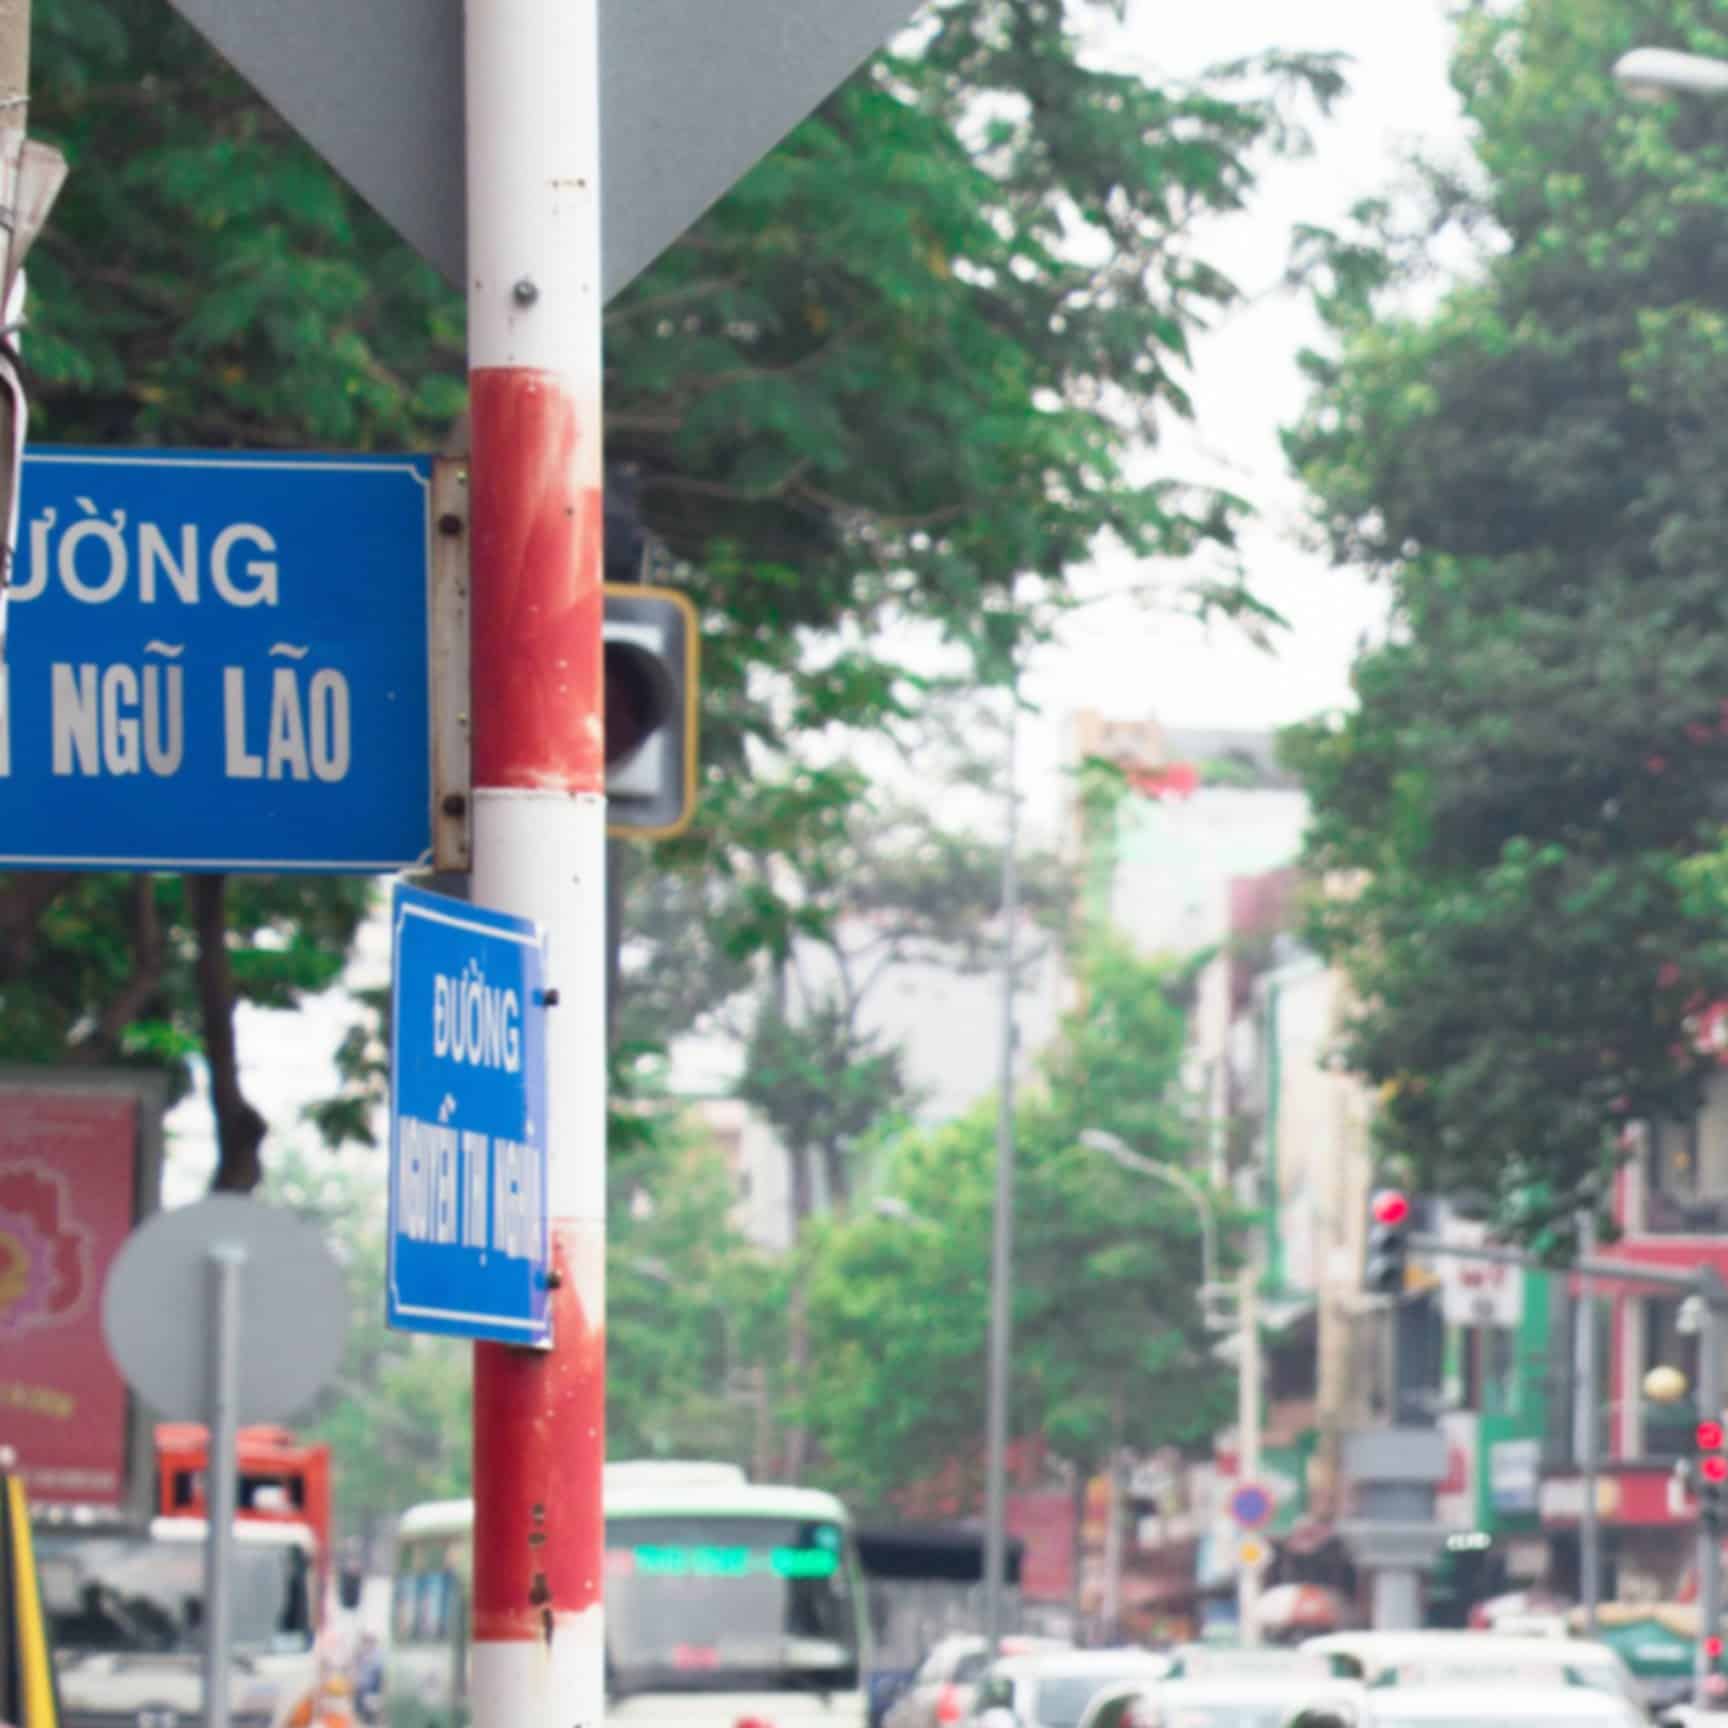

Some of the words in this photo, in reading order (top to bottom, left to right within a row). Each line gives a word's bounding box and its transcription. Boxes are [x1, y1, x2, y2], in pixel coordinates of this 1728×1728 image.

[51, 640, 185, 778] NGŨ
[222, 642, 351, 782] LÃO
[431, 957, 521, 1074] ĐƯỜNG
